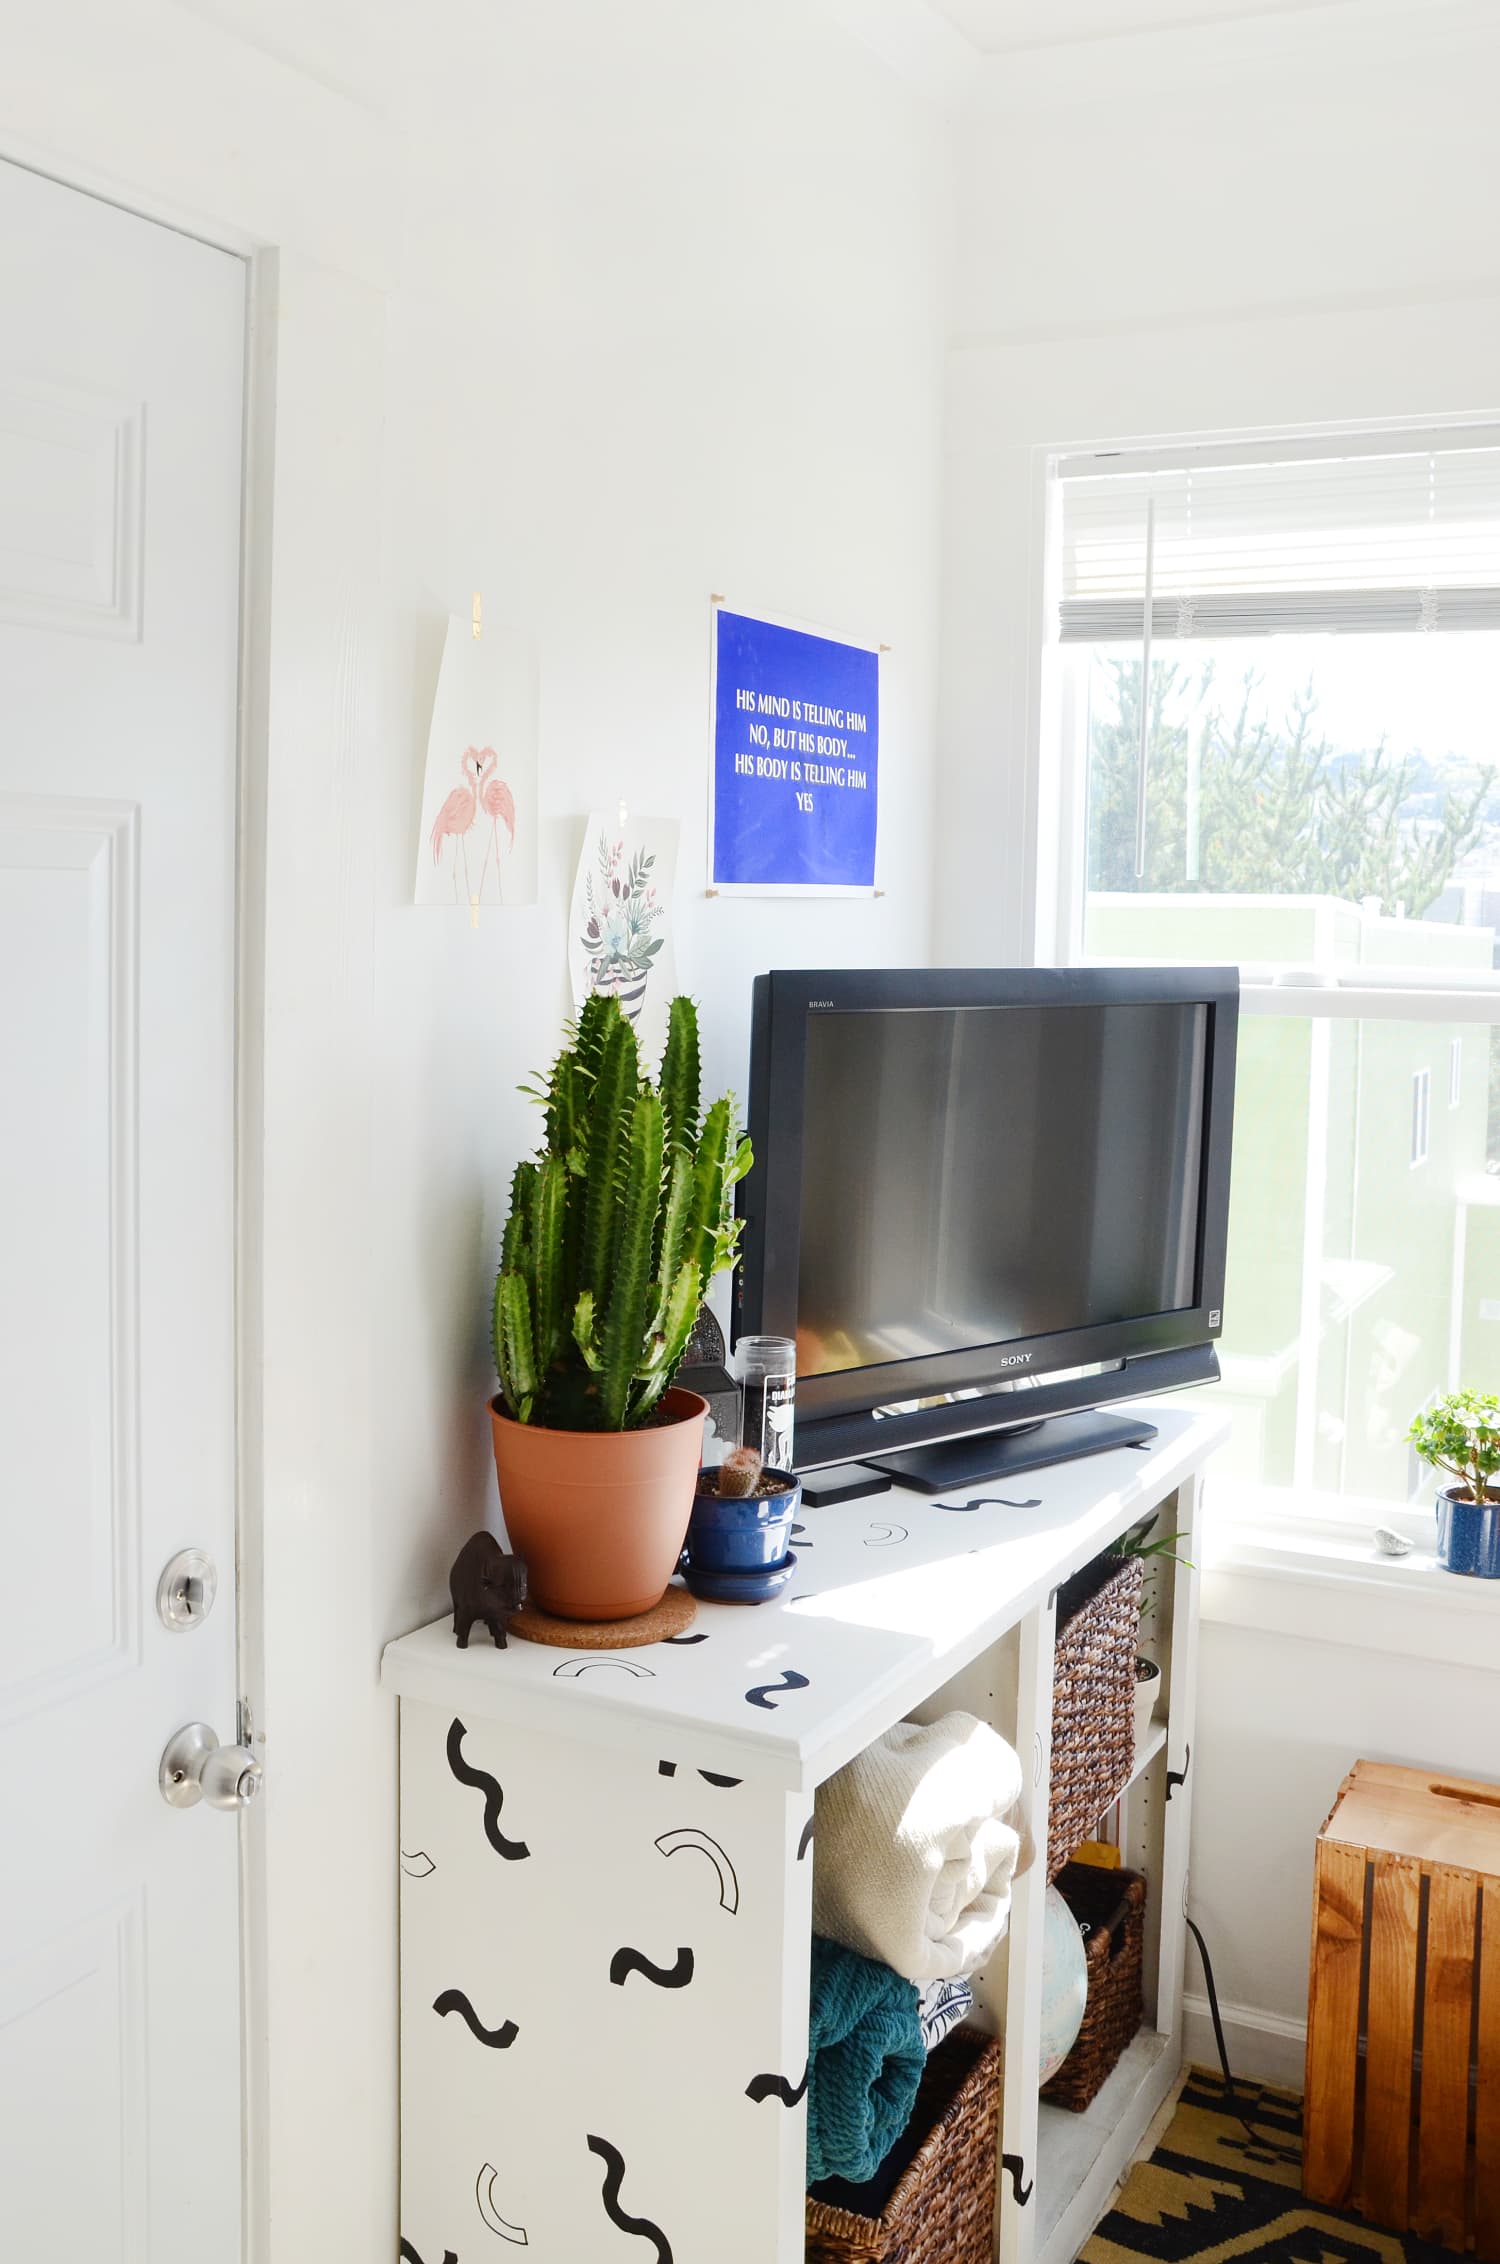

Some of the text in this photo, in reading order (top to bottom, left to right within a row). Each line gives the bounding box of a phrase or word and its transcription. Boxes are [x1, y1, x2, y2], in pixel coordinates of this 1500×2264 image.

[736, 688, 867, 733] HIS MIND IS TELLING HIM
[749, 723, 856, 760] NO, BUT HIS BODY...
[735, 753, 867, 789] HIS BODY IS TELLING HIM
[796, 792, 814, 812] YES
[808, 1001, 834, 1009] BRAVIA
[1000, 1353, 1032, 1367] SONY
